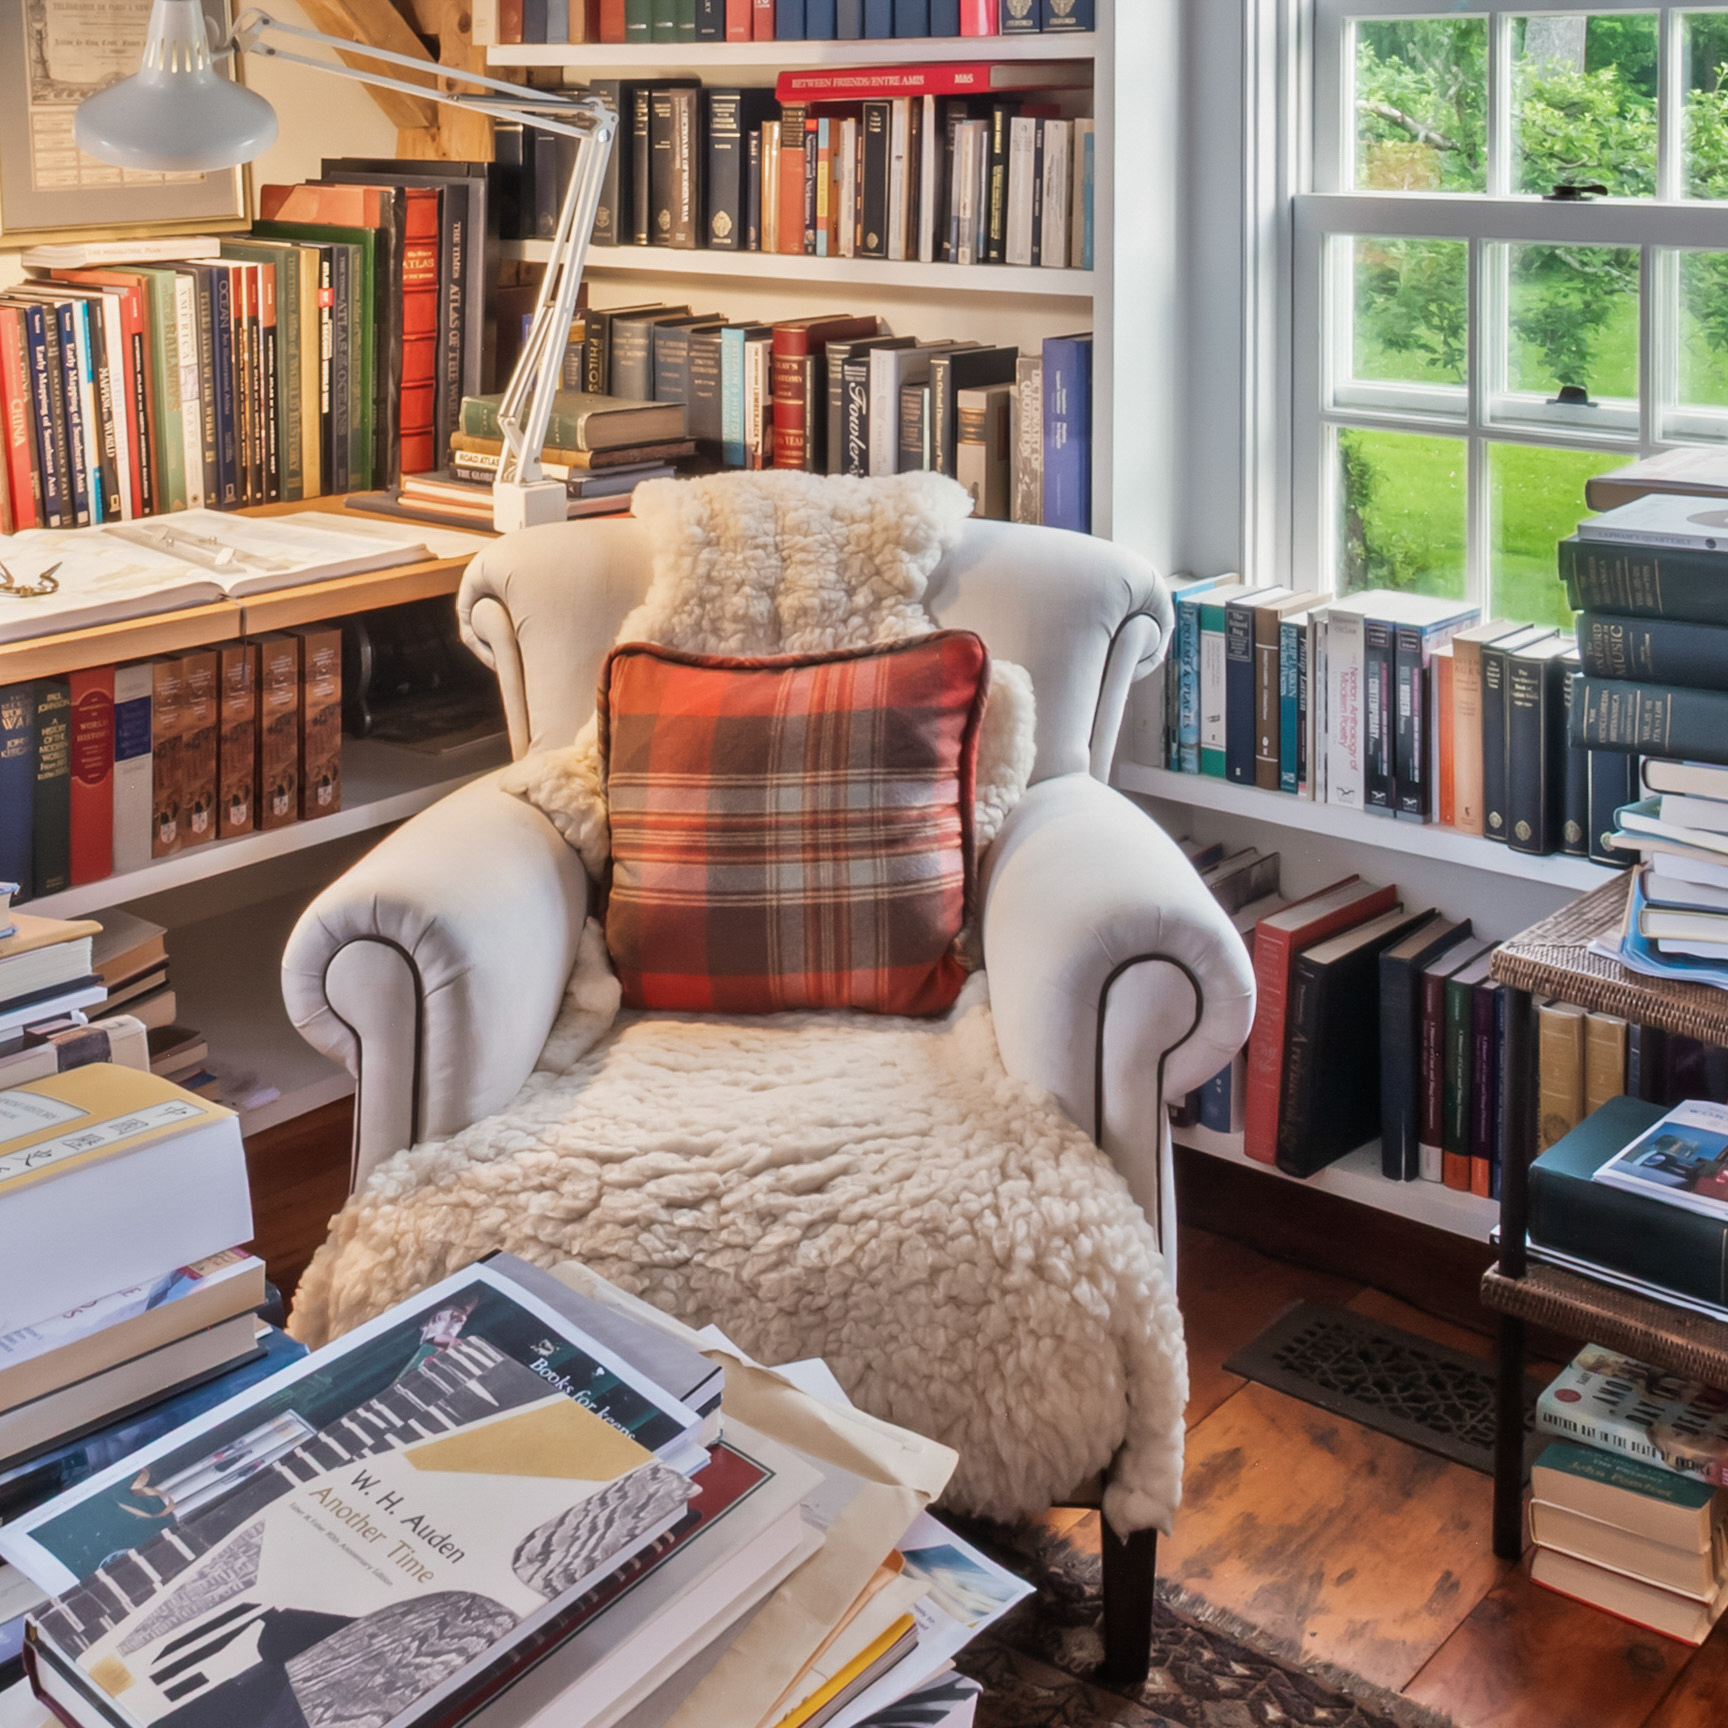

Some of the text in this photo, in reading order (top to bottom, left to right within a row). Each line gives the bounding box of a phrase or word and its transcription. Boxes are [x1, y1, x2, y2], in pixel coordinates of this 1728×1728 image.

[11, 398, 26, 447] CHINA
[36, 345, 56, 497] Early Mapping Southeast Asia
[529, 1357, 575, 1396] Books
[571, 1389, 597, 1416] for
[1543, 1413, 1656, 1459] ANOTHER DAY IN THE DEATH
[309, 1485, 436, 1585] Another Time
[350, 1468, 466, 1565] W. H. Auden
